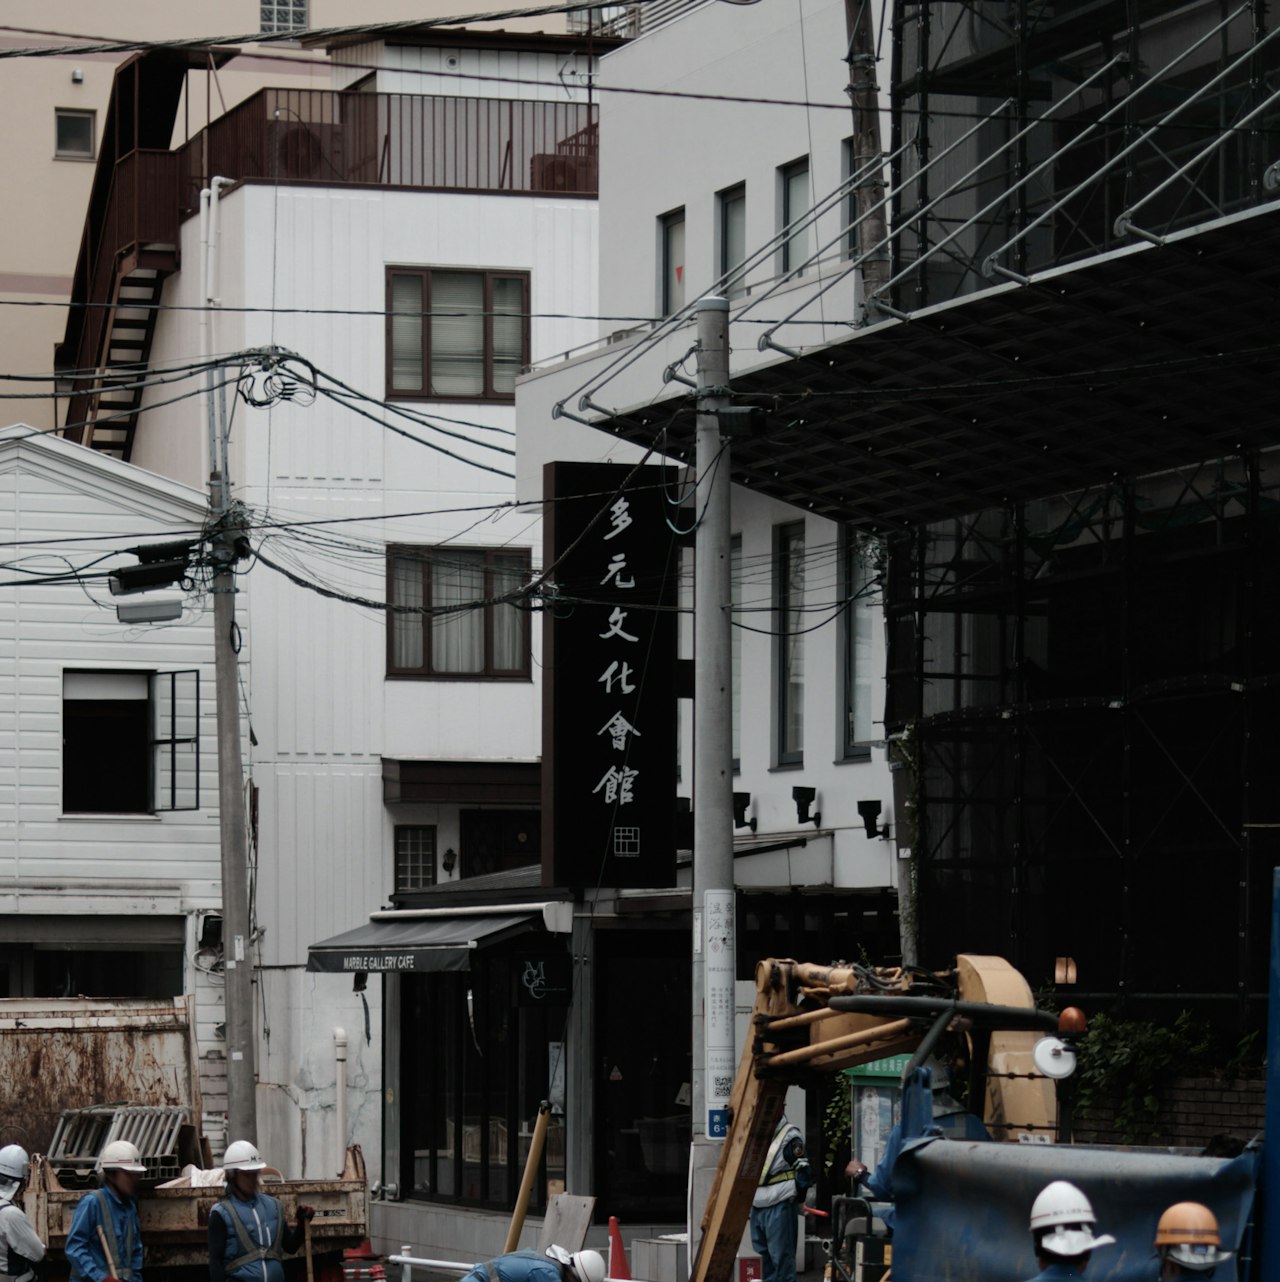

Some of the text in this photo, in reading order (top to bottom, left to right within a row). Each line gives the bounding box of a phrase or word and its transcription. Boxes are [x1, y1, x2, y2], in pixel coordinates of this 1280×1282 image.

[592, 496, 642, 806] 多元文化會館
[343, 955, 415, 970] MARBLE GALLERY CAFE
